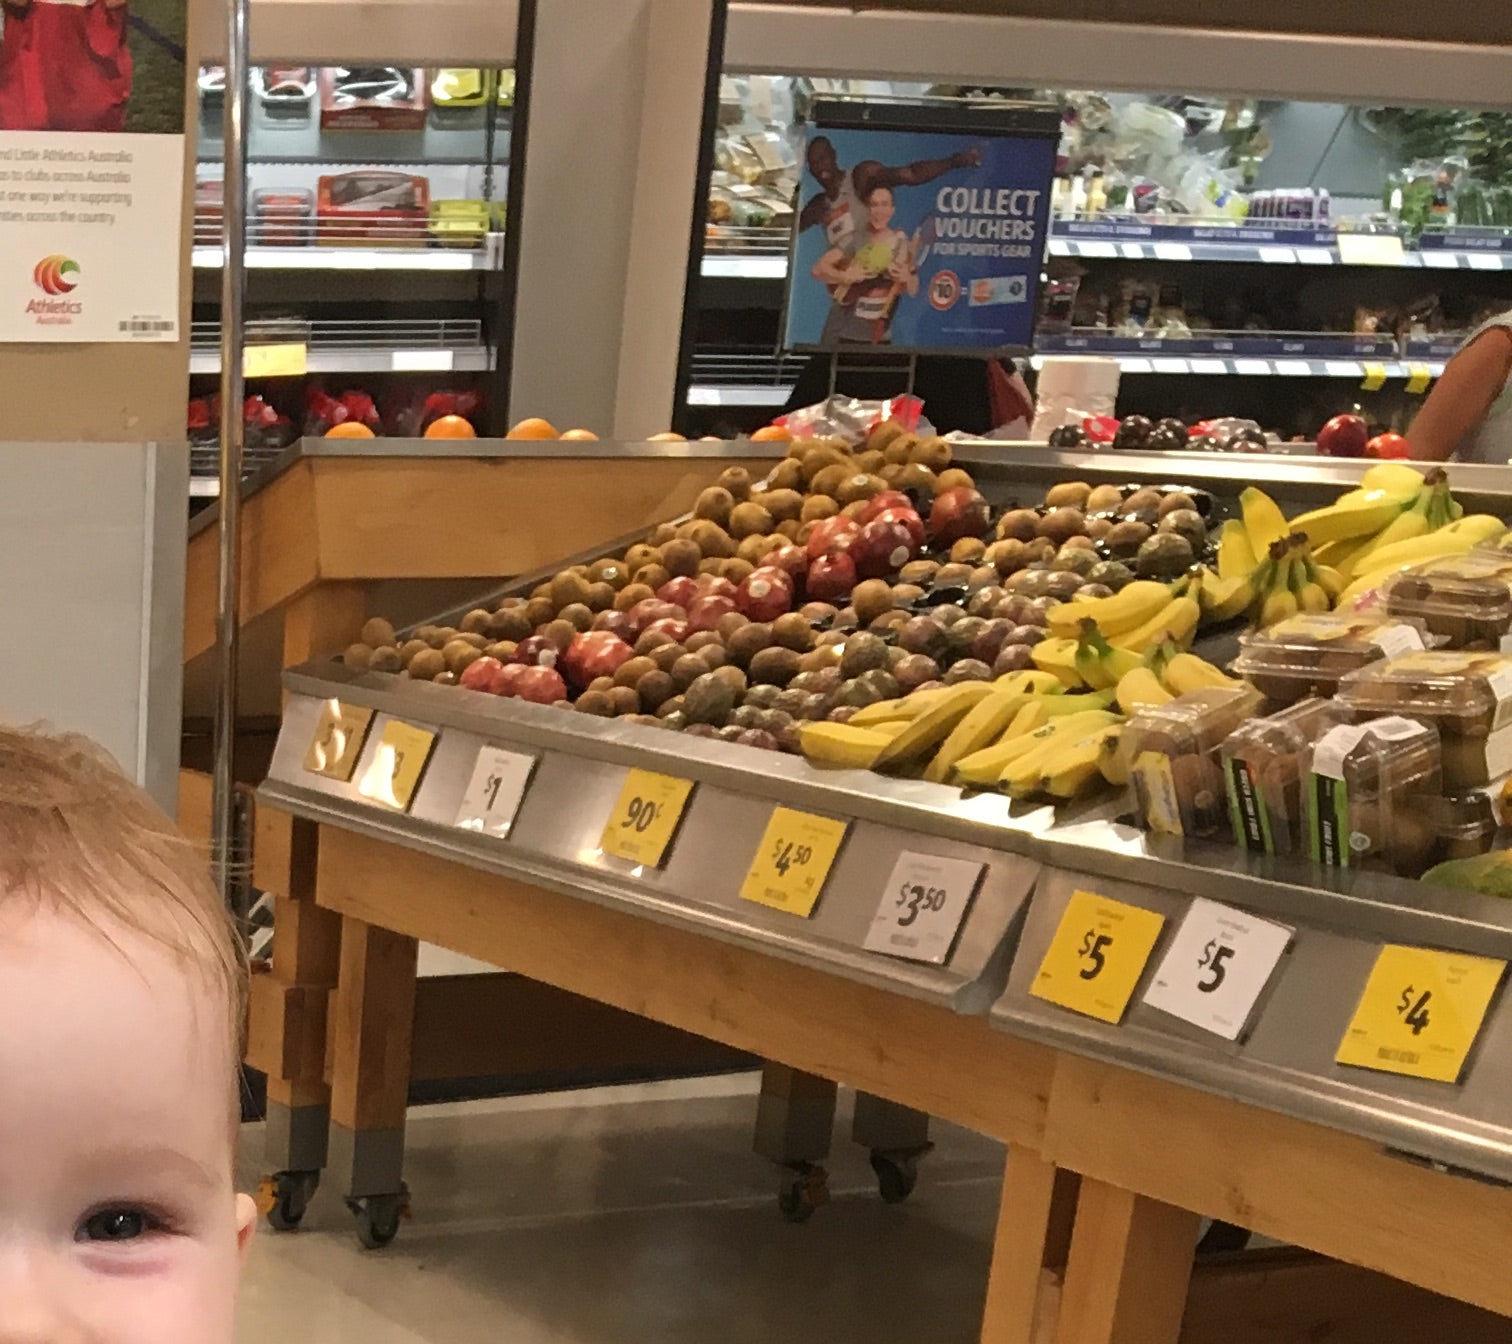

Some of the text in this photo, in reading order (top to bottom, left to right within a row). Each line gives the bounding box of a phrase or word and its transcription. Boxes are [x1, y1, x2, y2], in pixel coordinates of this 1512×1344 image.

[937, 186, 1040, 216] COLLECT
[934, 217, 1035, 240] VOUCHERS
[25, 299, 83, 314] Athletics
[1078, 928, 1114, 981] $5
[1198, 939, 1235, 994] $5
[1396, 985, 1432, 1037] $4
